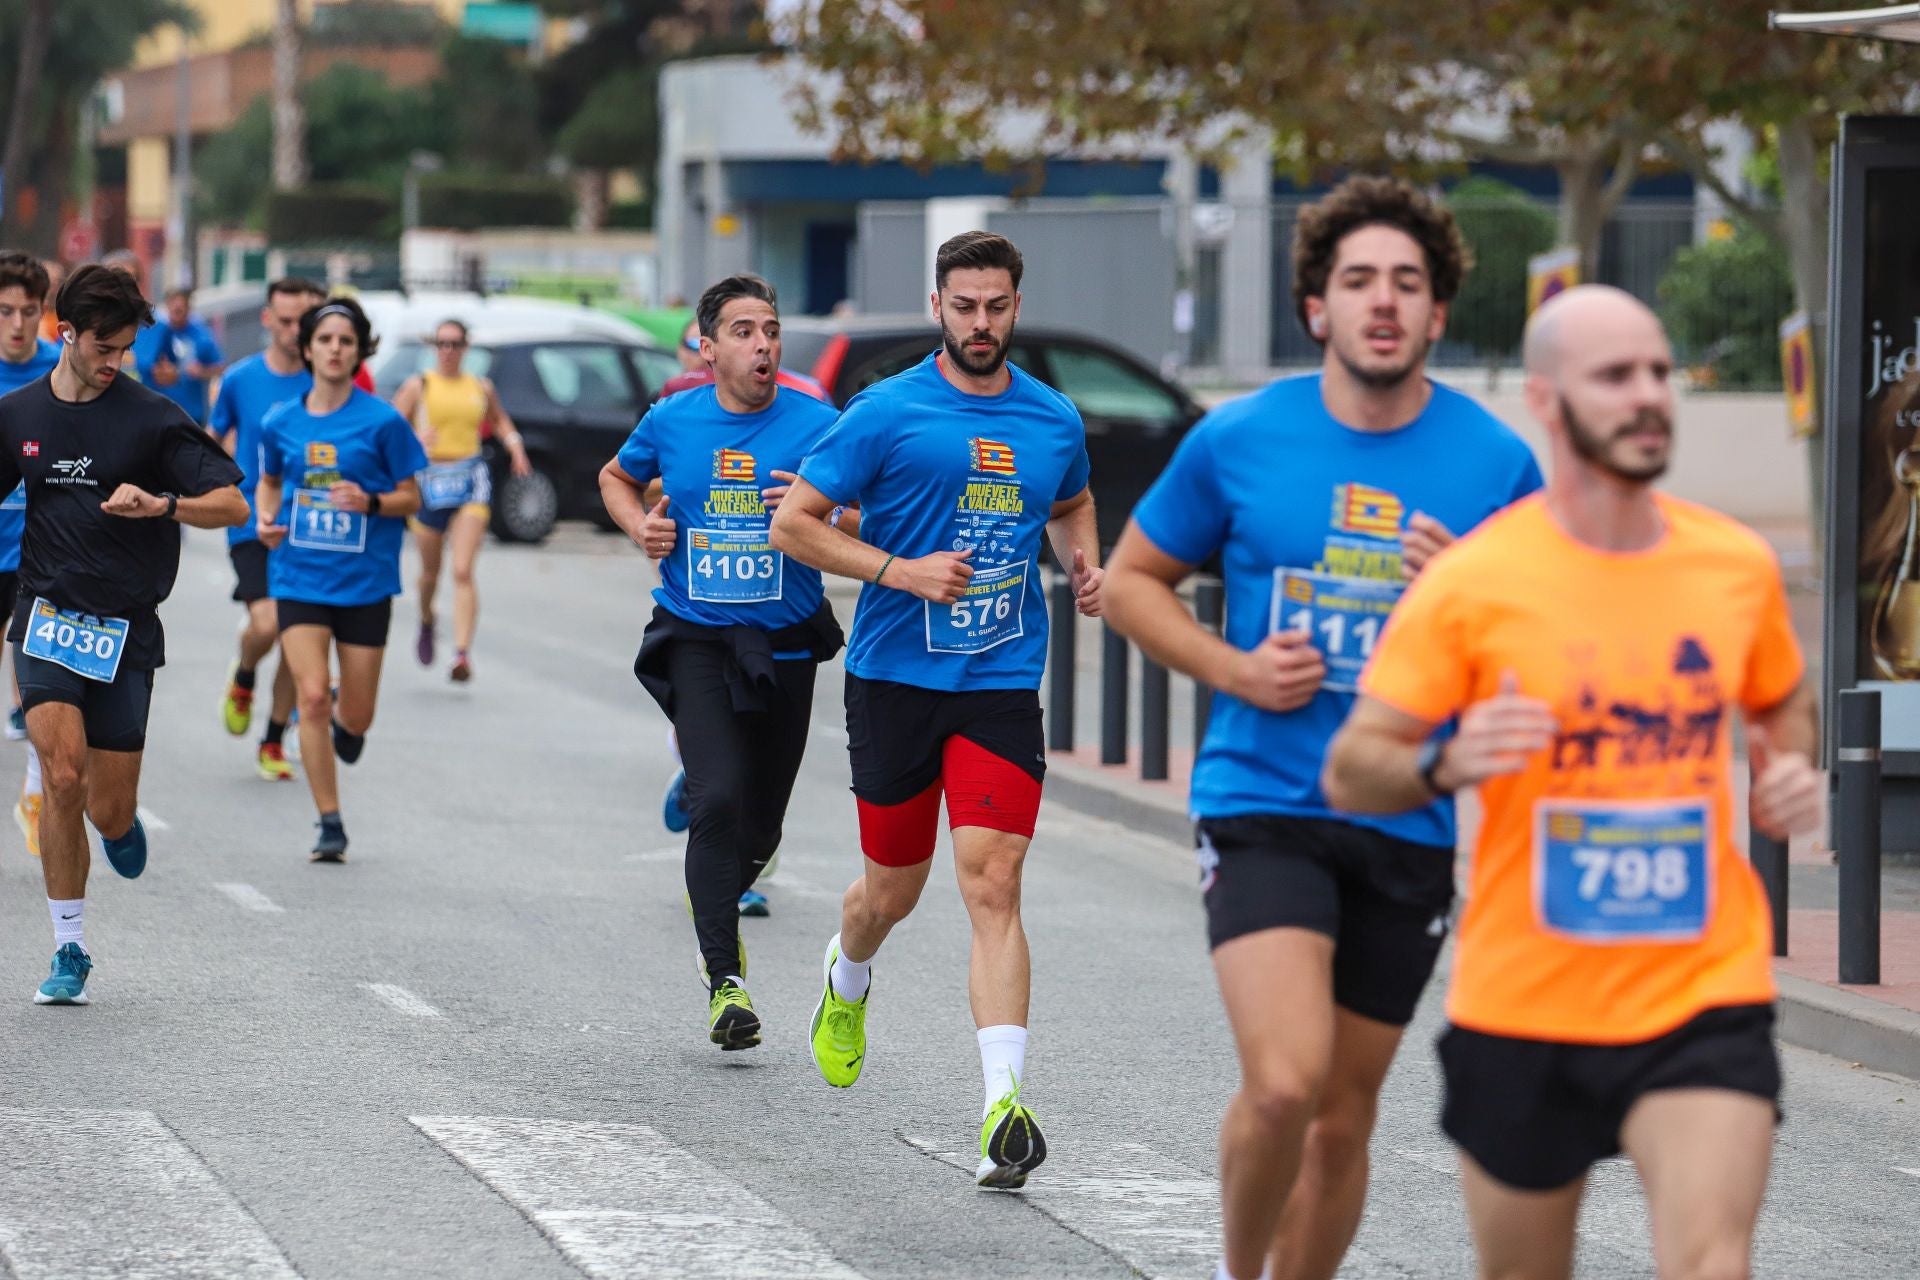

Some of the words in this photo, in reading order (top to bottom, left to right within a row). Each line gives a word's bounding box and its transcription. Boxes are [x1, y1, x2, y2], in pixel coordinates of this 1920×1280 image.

[710, 488, 759, 503] MUÉVETE
[966, 482, 1020, 500] MUÉVETE
[704, 502, 711, 514] X
[714, 502, 766, 514] VALENCIA
[957, 495, 967, 509] X
[968, 496, 1024, 513] VALENCIA
[306, 508, 352, 534] 113
[749, 543, 773, 551] VALEN
[696, 554, 774, 580] 4103
[950, 593, 1010, 628] 576
[36, 620, 115, 660] 4030
[1571, 847, 1690, 901] 798
